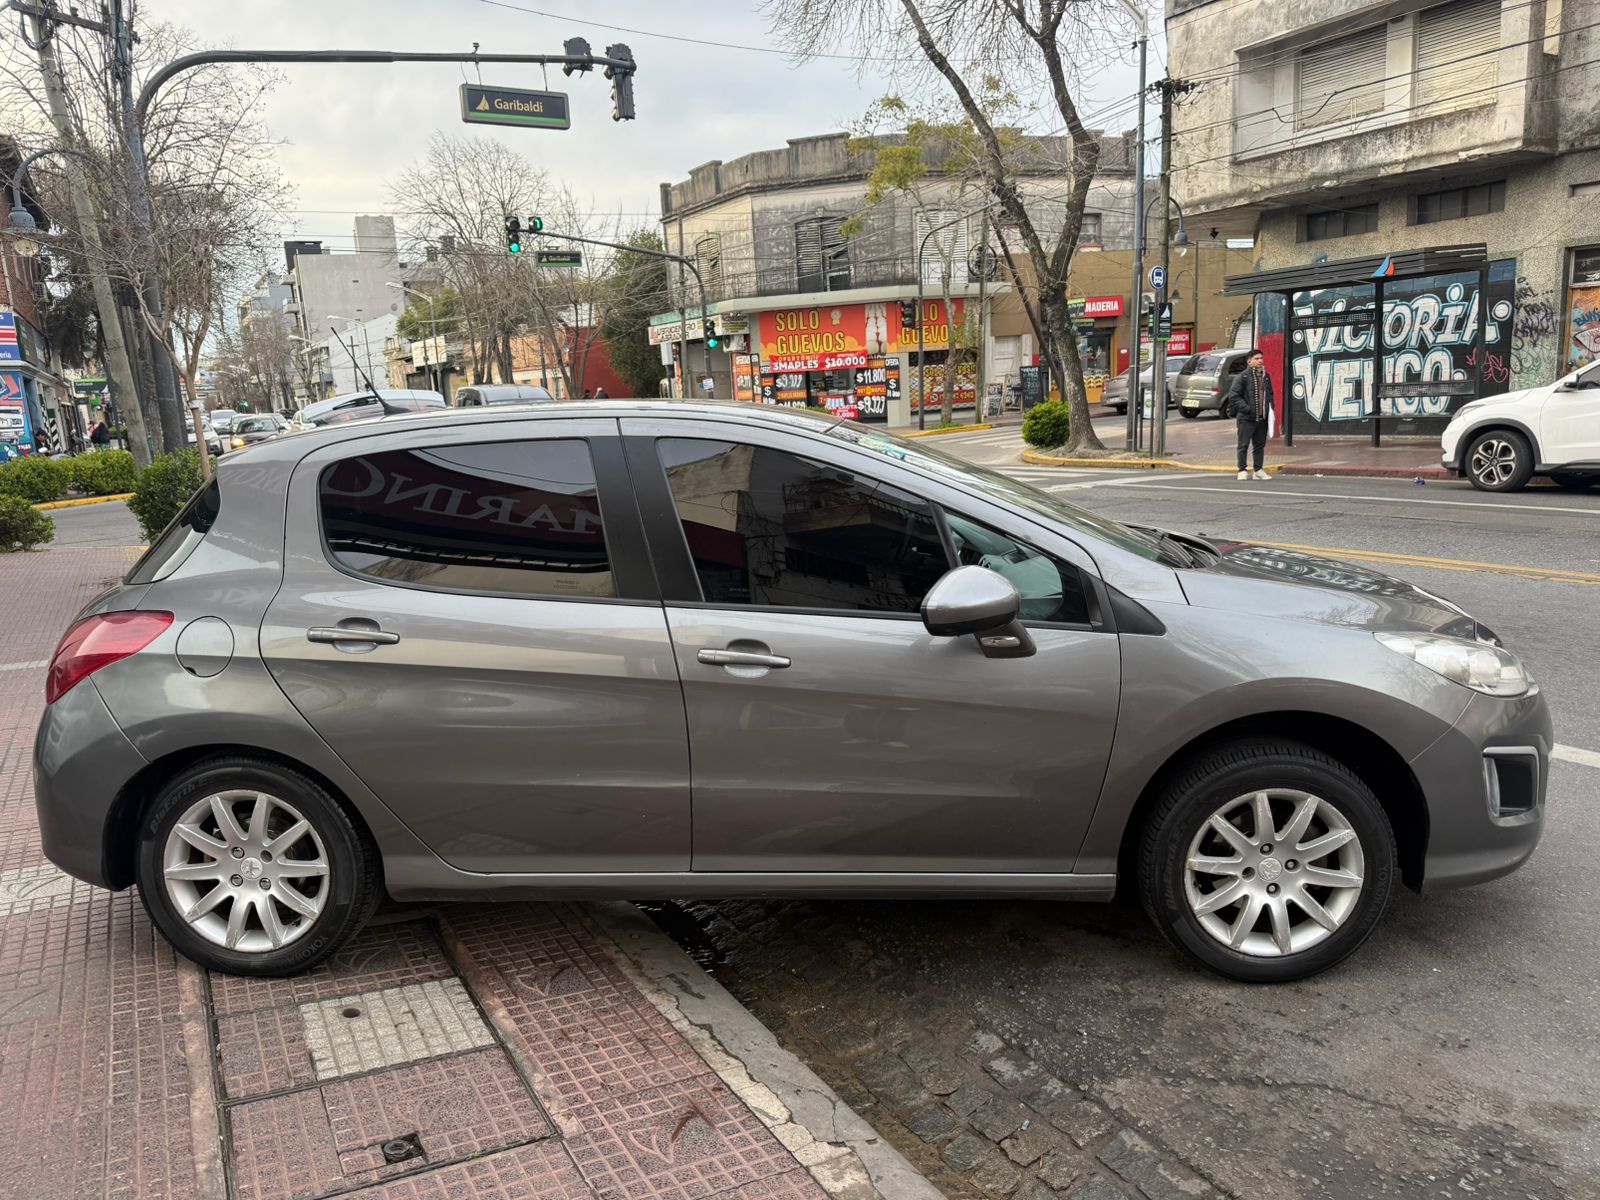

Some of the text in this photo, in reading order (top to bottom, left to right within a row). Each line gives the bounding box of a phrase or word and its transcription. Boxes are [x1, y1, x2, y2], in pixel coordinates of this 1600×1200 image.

[494, 98, 543, 112] Garibaldi
[1085, 300, 1119, 312] NADERIA
[775, 310, 820, 332] SOLO
[776, 331, 846, 355] GUEVOS
[902, 324, 957, 345] GUEVO
[773, 360, 819, 371] 3MAPLES
[825, 356, 866, 369] $10.000
